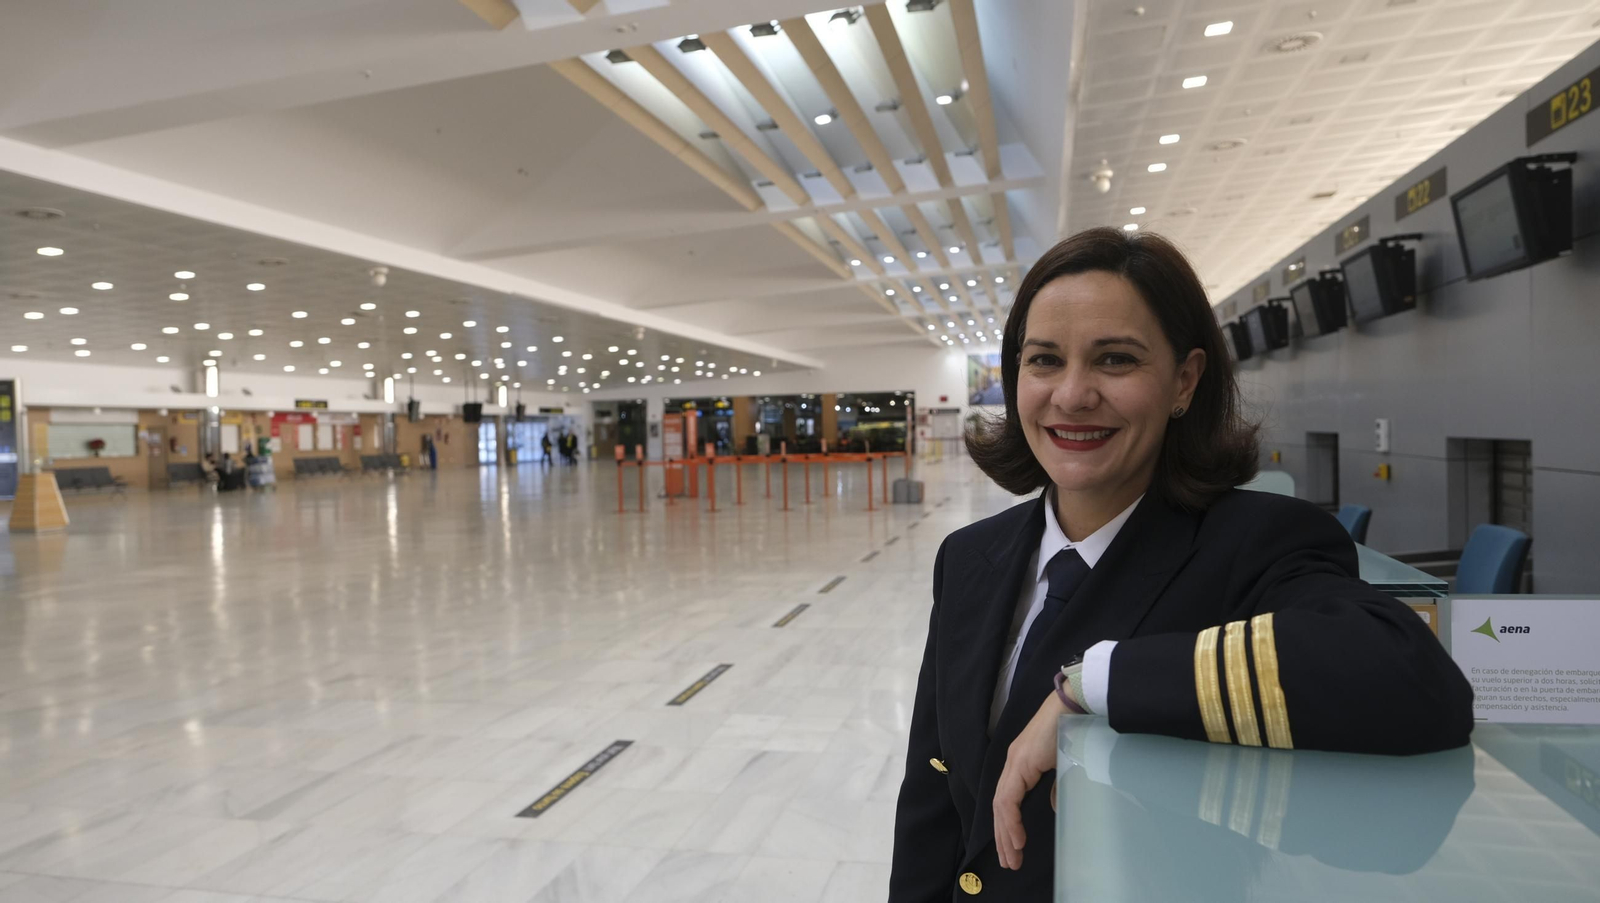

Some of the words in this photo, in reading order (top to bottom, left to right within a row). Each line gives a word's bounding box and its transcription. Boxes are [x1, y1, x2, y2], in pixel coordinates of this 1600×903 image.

[1567, 77, 1592, 120] 23
[1499, 625, 1531, 634] aena
[1511, 668, 1553, 677] denegación
[1503, 676, 1532, 685] superior
[1555, 677, 1578, 685] horas,
[1531, 685, 1538, 693] la
[1565, 686, 1575, 694] de
